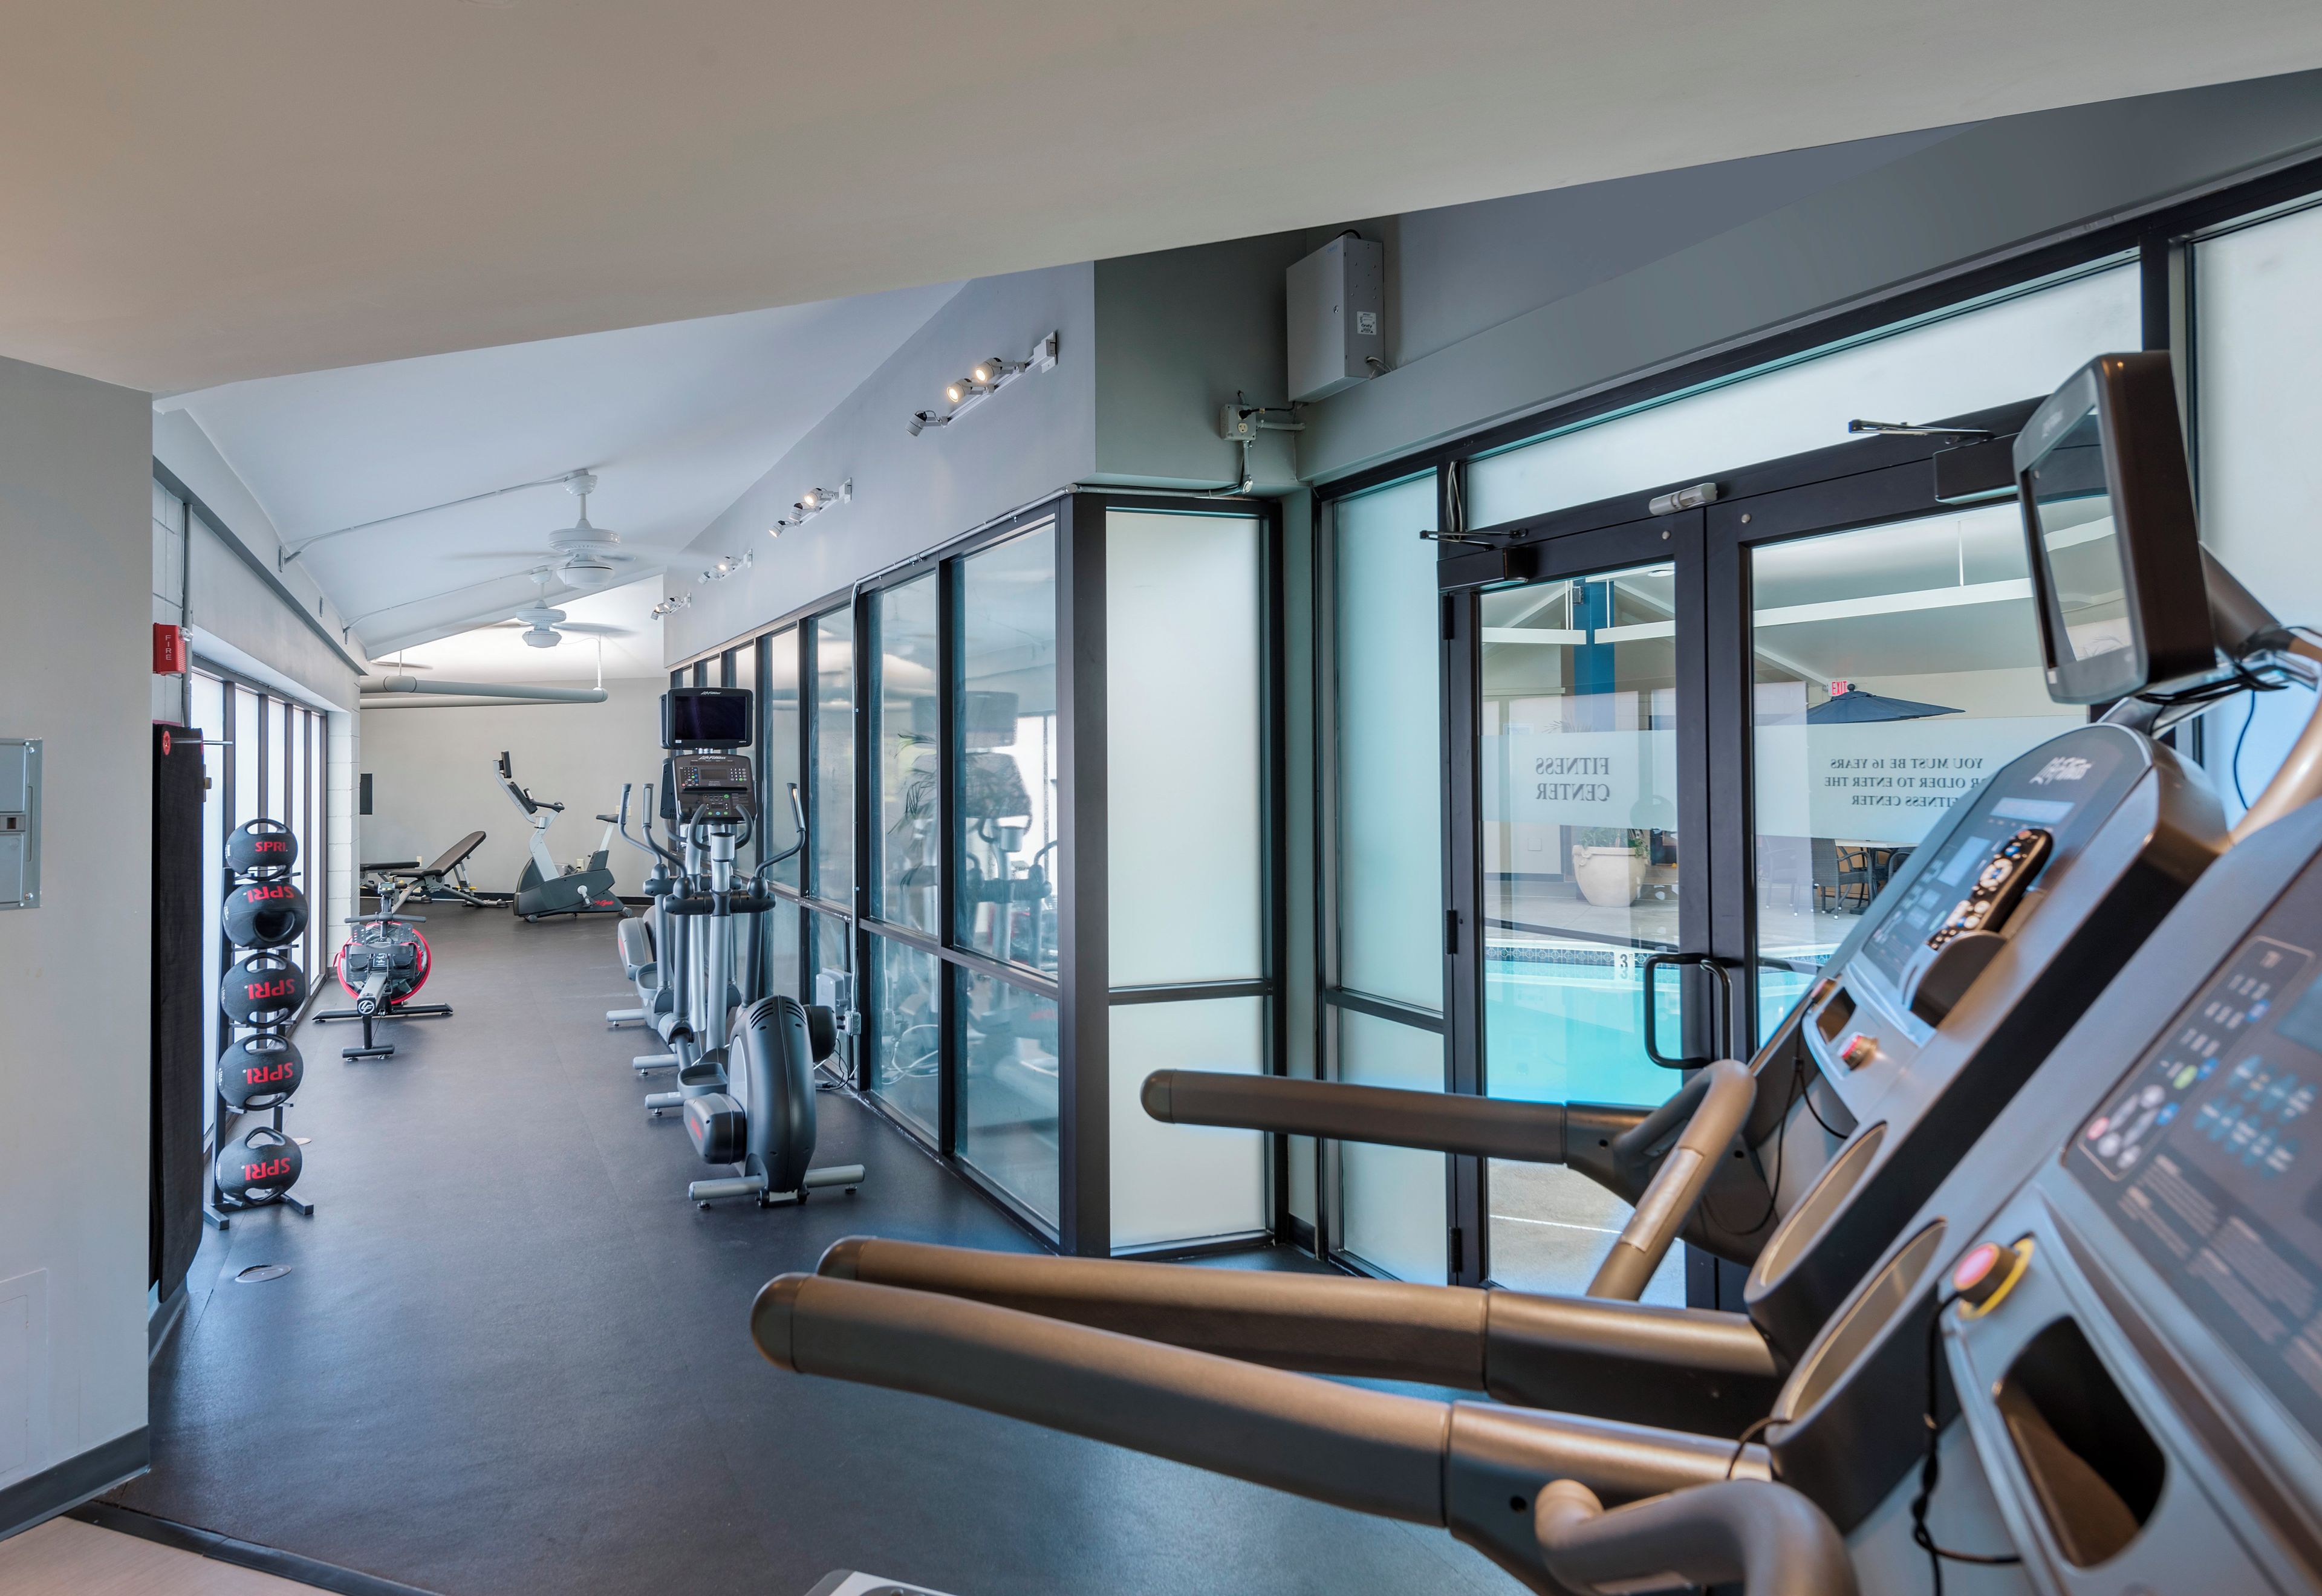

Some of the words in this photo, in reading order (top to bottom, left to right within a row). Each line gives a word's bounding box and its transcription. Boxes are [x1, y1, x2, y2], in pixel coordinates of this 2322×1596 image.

[1832, 681, 1847, 695] EXIT
[255, 841, 285, 852] SPRI
[247, 886, 294, 903] SPRI
[1620, 953, 1628, 967] 3
[248, 978, 296, 1000] SPRI
[247, 1062, 294, 1085] SPRI
[245, 1157, 291, 1181] SPRI
